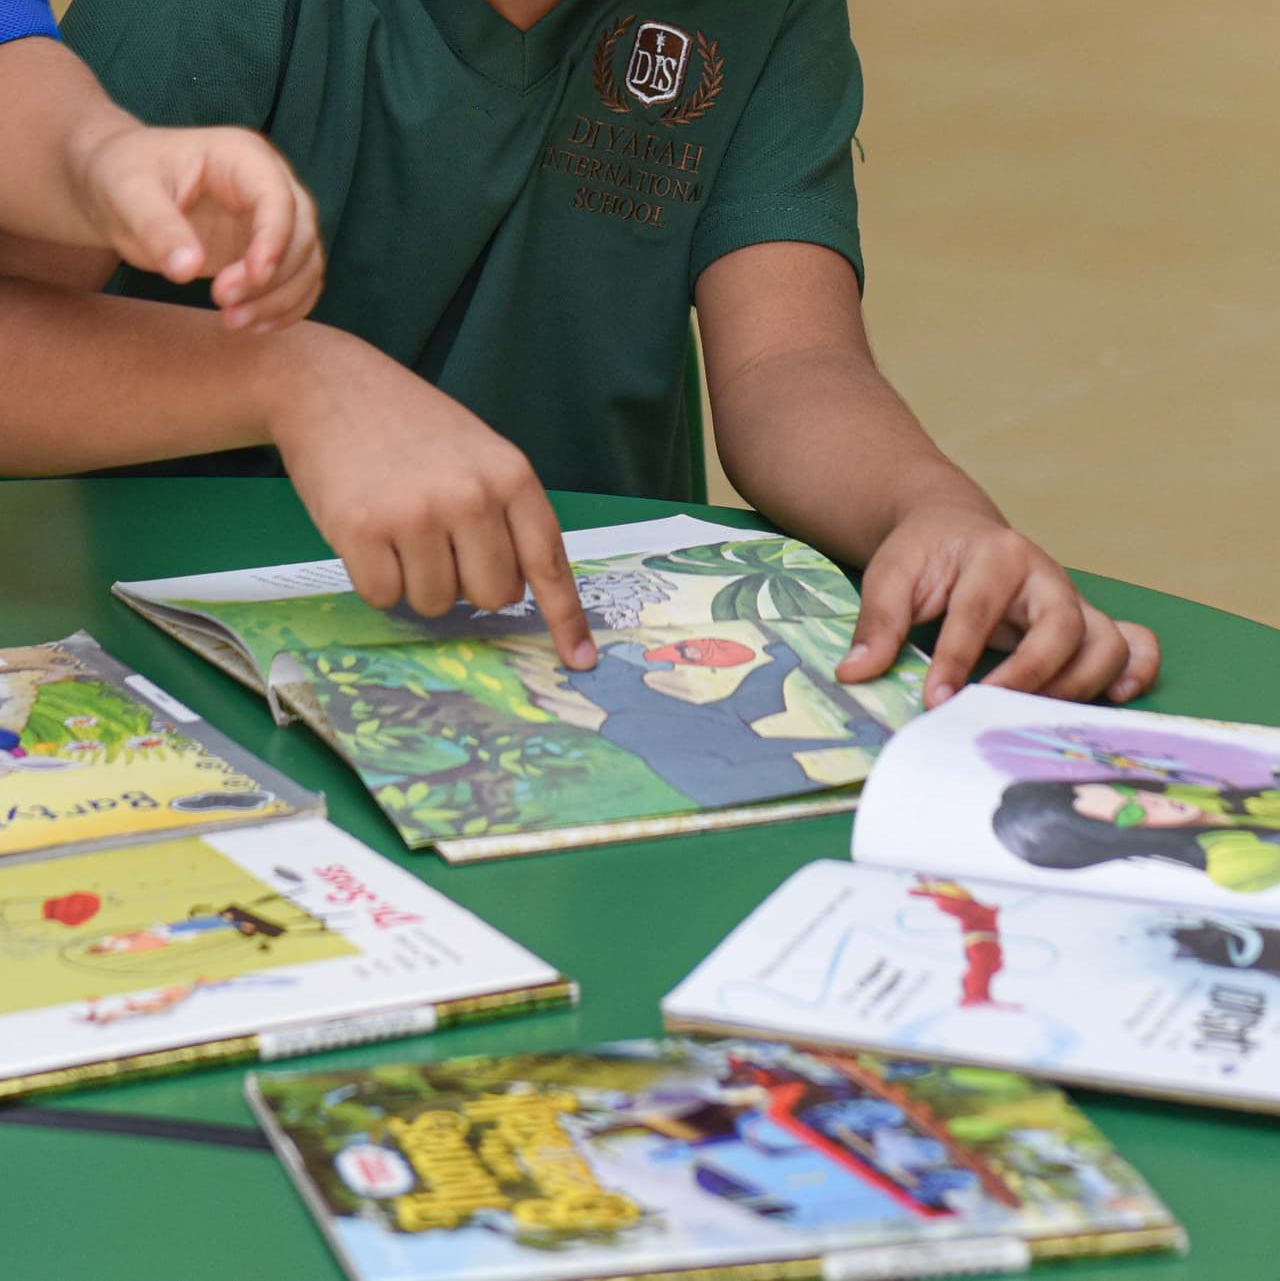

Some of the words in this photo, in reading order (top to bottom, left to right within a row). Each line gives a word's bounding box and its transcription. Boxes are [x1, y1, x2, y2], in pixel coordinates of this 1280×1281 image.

[631, 49, 677, 92] DIS
[567, 114, 705, 175] DIYAFAH
[540, 147, 704, 203] INTERNATIONAL
[573, 186, 666, 228] SCHOOL
